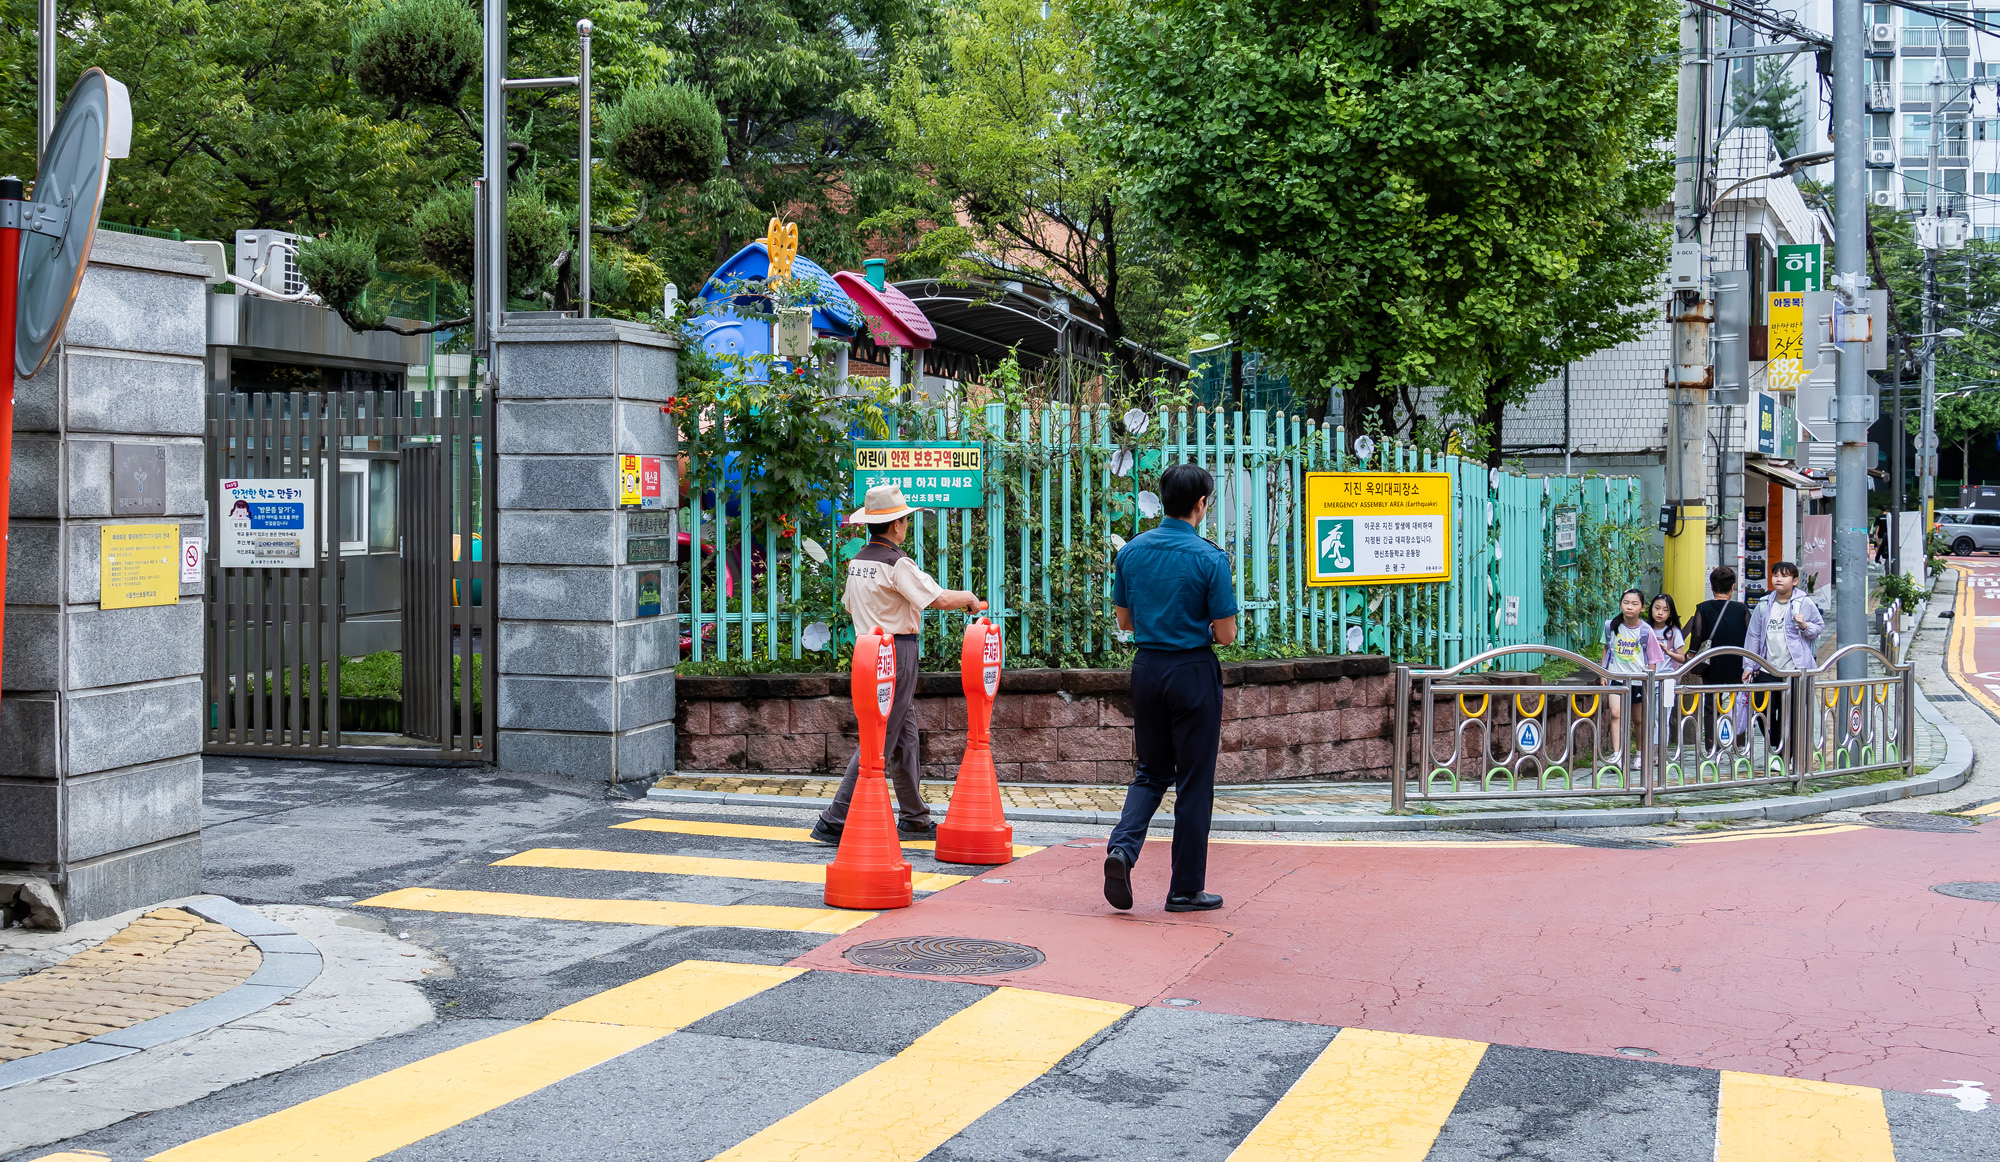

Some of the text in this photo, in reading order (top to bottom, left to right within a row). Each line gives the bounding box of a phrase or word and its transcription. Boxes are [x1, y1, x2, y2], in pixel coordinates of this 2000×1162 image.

[1773, 298, 1804, 308] 아동복
[1771, 322, 1803, 334] 반짝반
[1769, 358, 1800, 374] 382
[858, 451, 979, 468] 어린이 안전 보호구역입니다
[916, 477, 937, 488] 하지
[941, 477, 972, 488] 마세요
[232, 487, 301, 500] 안전한 학교 만들기
[1343, 481, 1420, 497] 지진 옥외대피장소
[1364, 521, 1433, 530] 이곳은 지진 발생에 대비하여
[1364, 537, 1381, 545] 지정된
[1383, 536, 1393, 544] 긴급
[1374, 549, 1421, 558] 연신초등학교 운동장
[849, 566, 878, 579] 교보안관
[1618, 647, 1634, 656] Lime
[1853, 717, 1859, 726] 30
